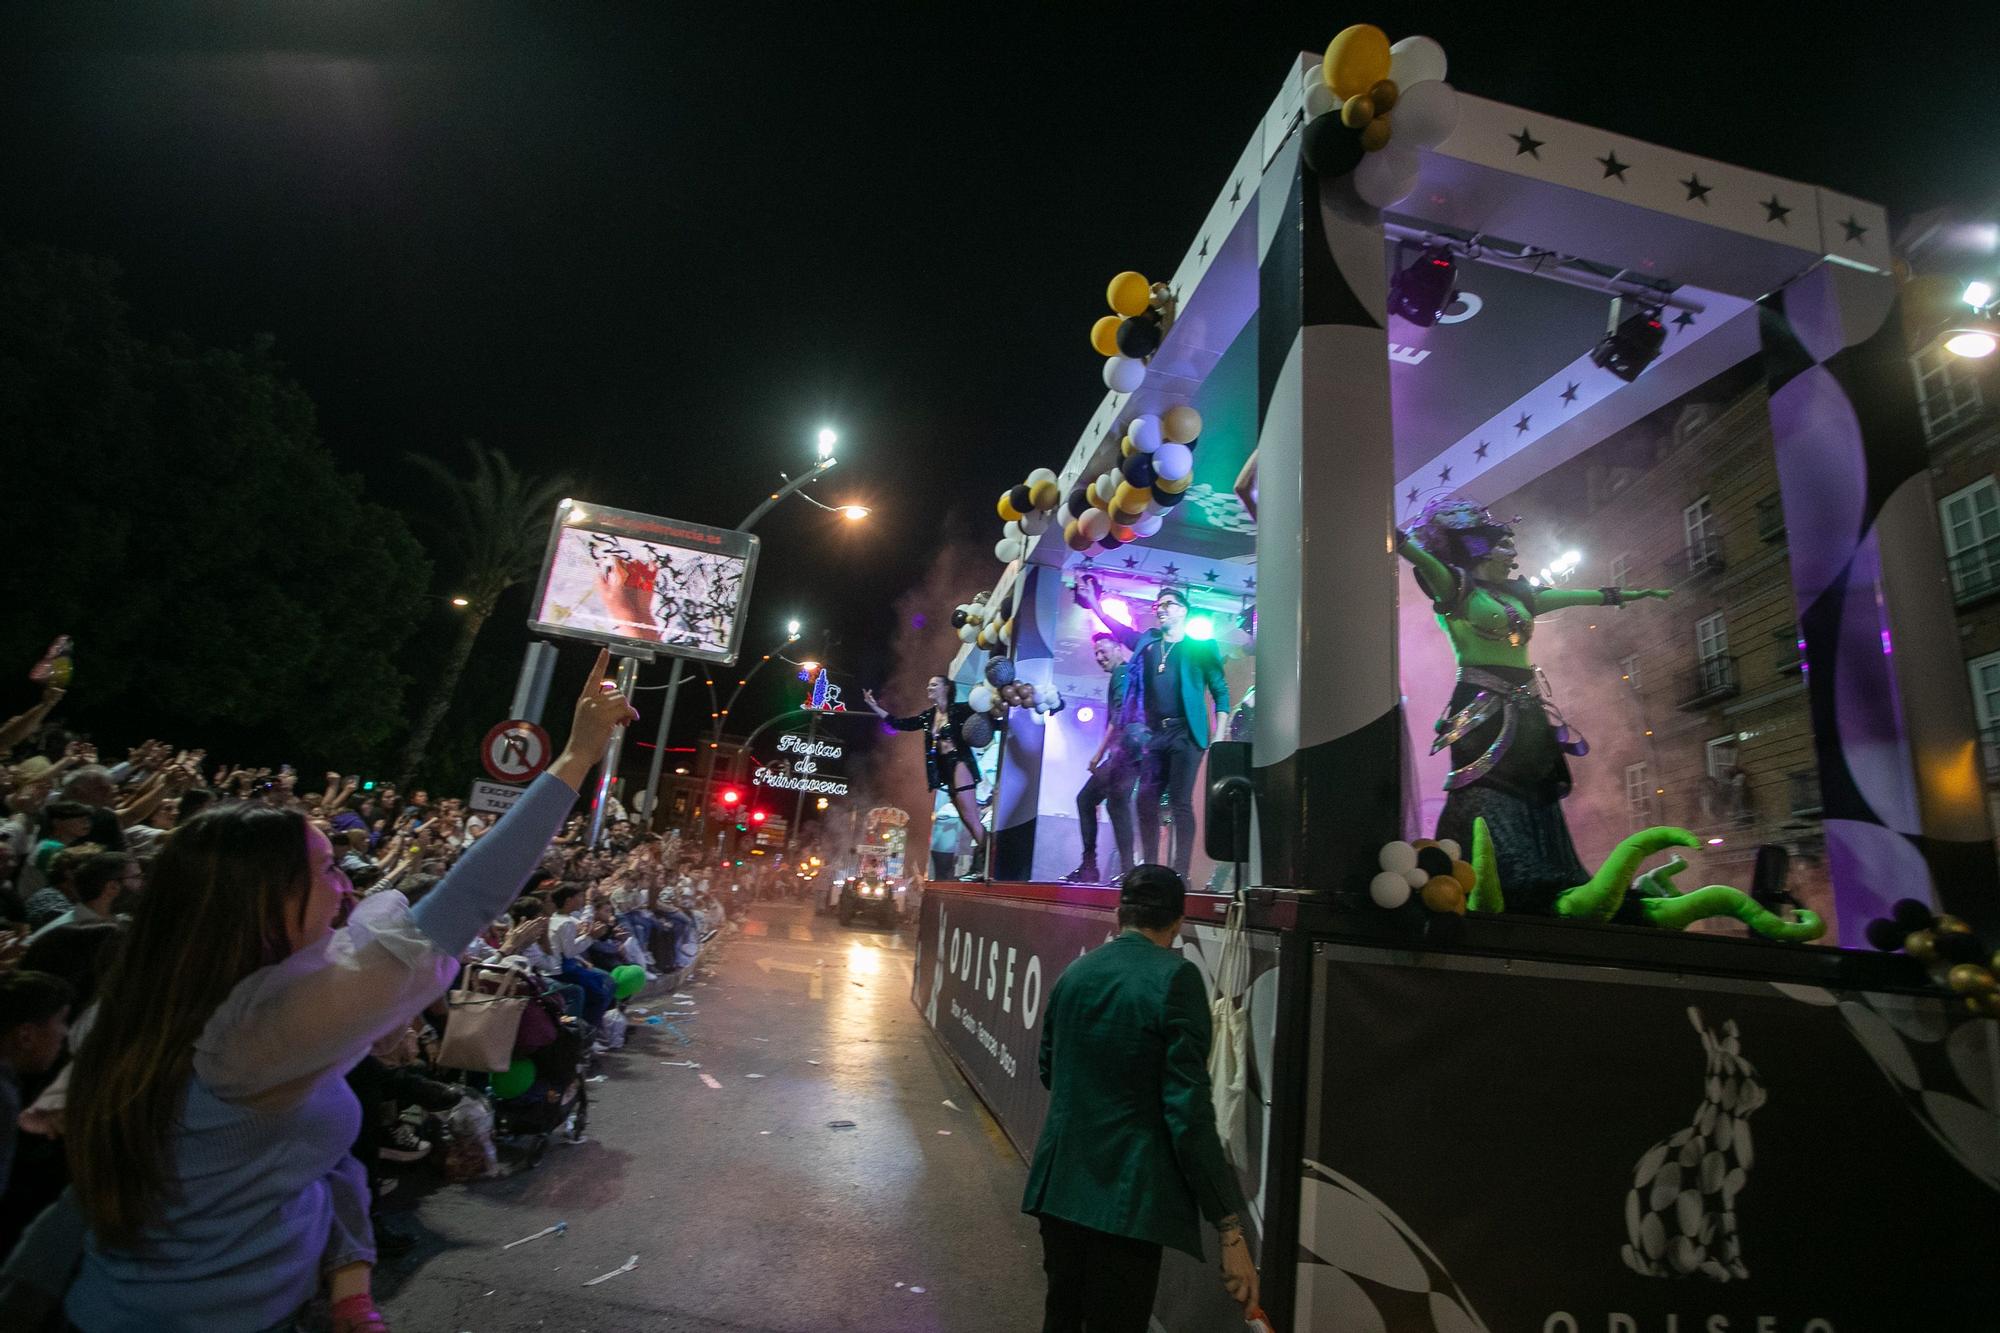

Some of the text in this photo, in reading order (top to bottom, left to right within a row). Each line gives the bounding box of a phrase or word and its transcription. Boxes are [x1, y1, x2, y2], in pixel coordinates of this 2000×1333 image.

[776, 735, 842, 758] Fiestas
[794, 755, 818, 774] de
[480, 786, 524, 799] EXCEPT
[752, 767, 848, 796] Primavera
[950, 927, 1042, 1030] ODISEO
